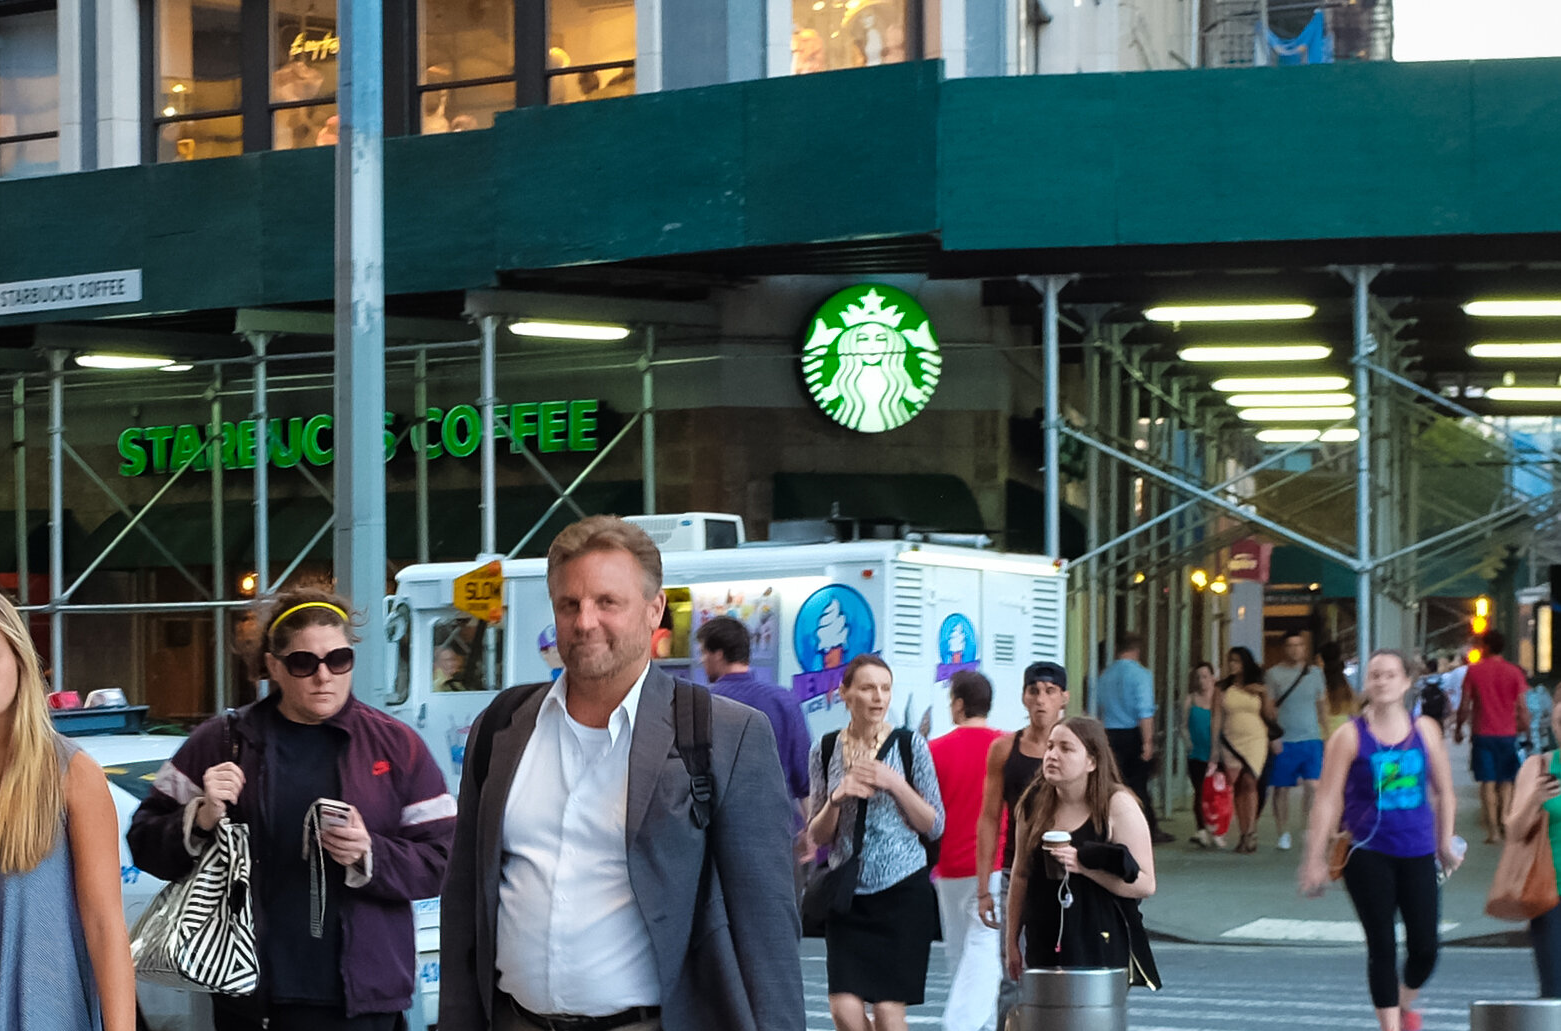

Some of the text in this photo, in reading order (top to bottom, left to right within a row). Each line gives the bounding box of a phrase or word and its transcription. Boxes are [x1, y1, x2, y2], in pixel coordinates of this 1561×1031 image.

[0, 278, 126, 307] STARBUCKS COFFEE
[118, 400, 598, 476] STARBUC COFFEE
